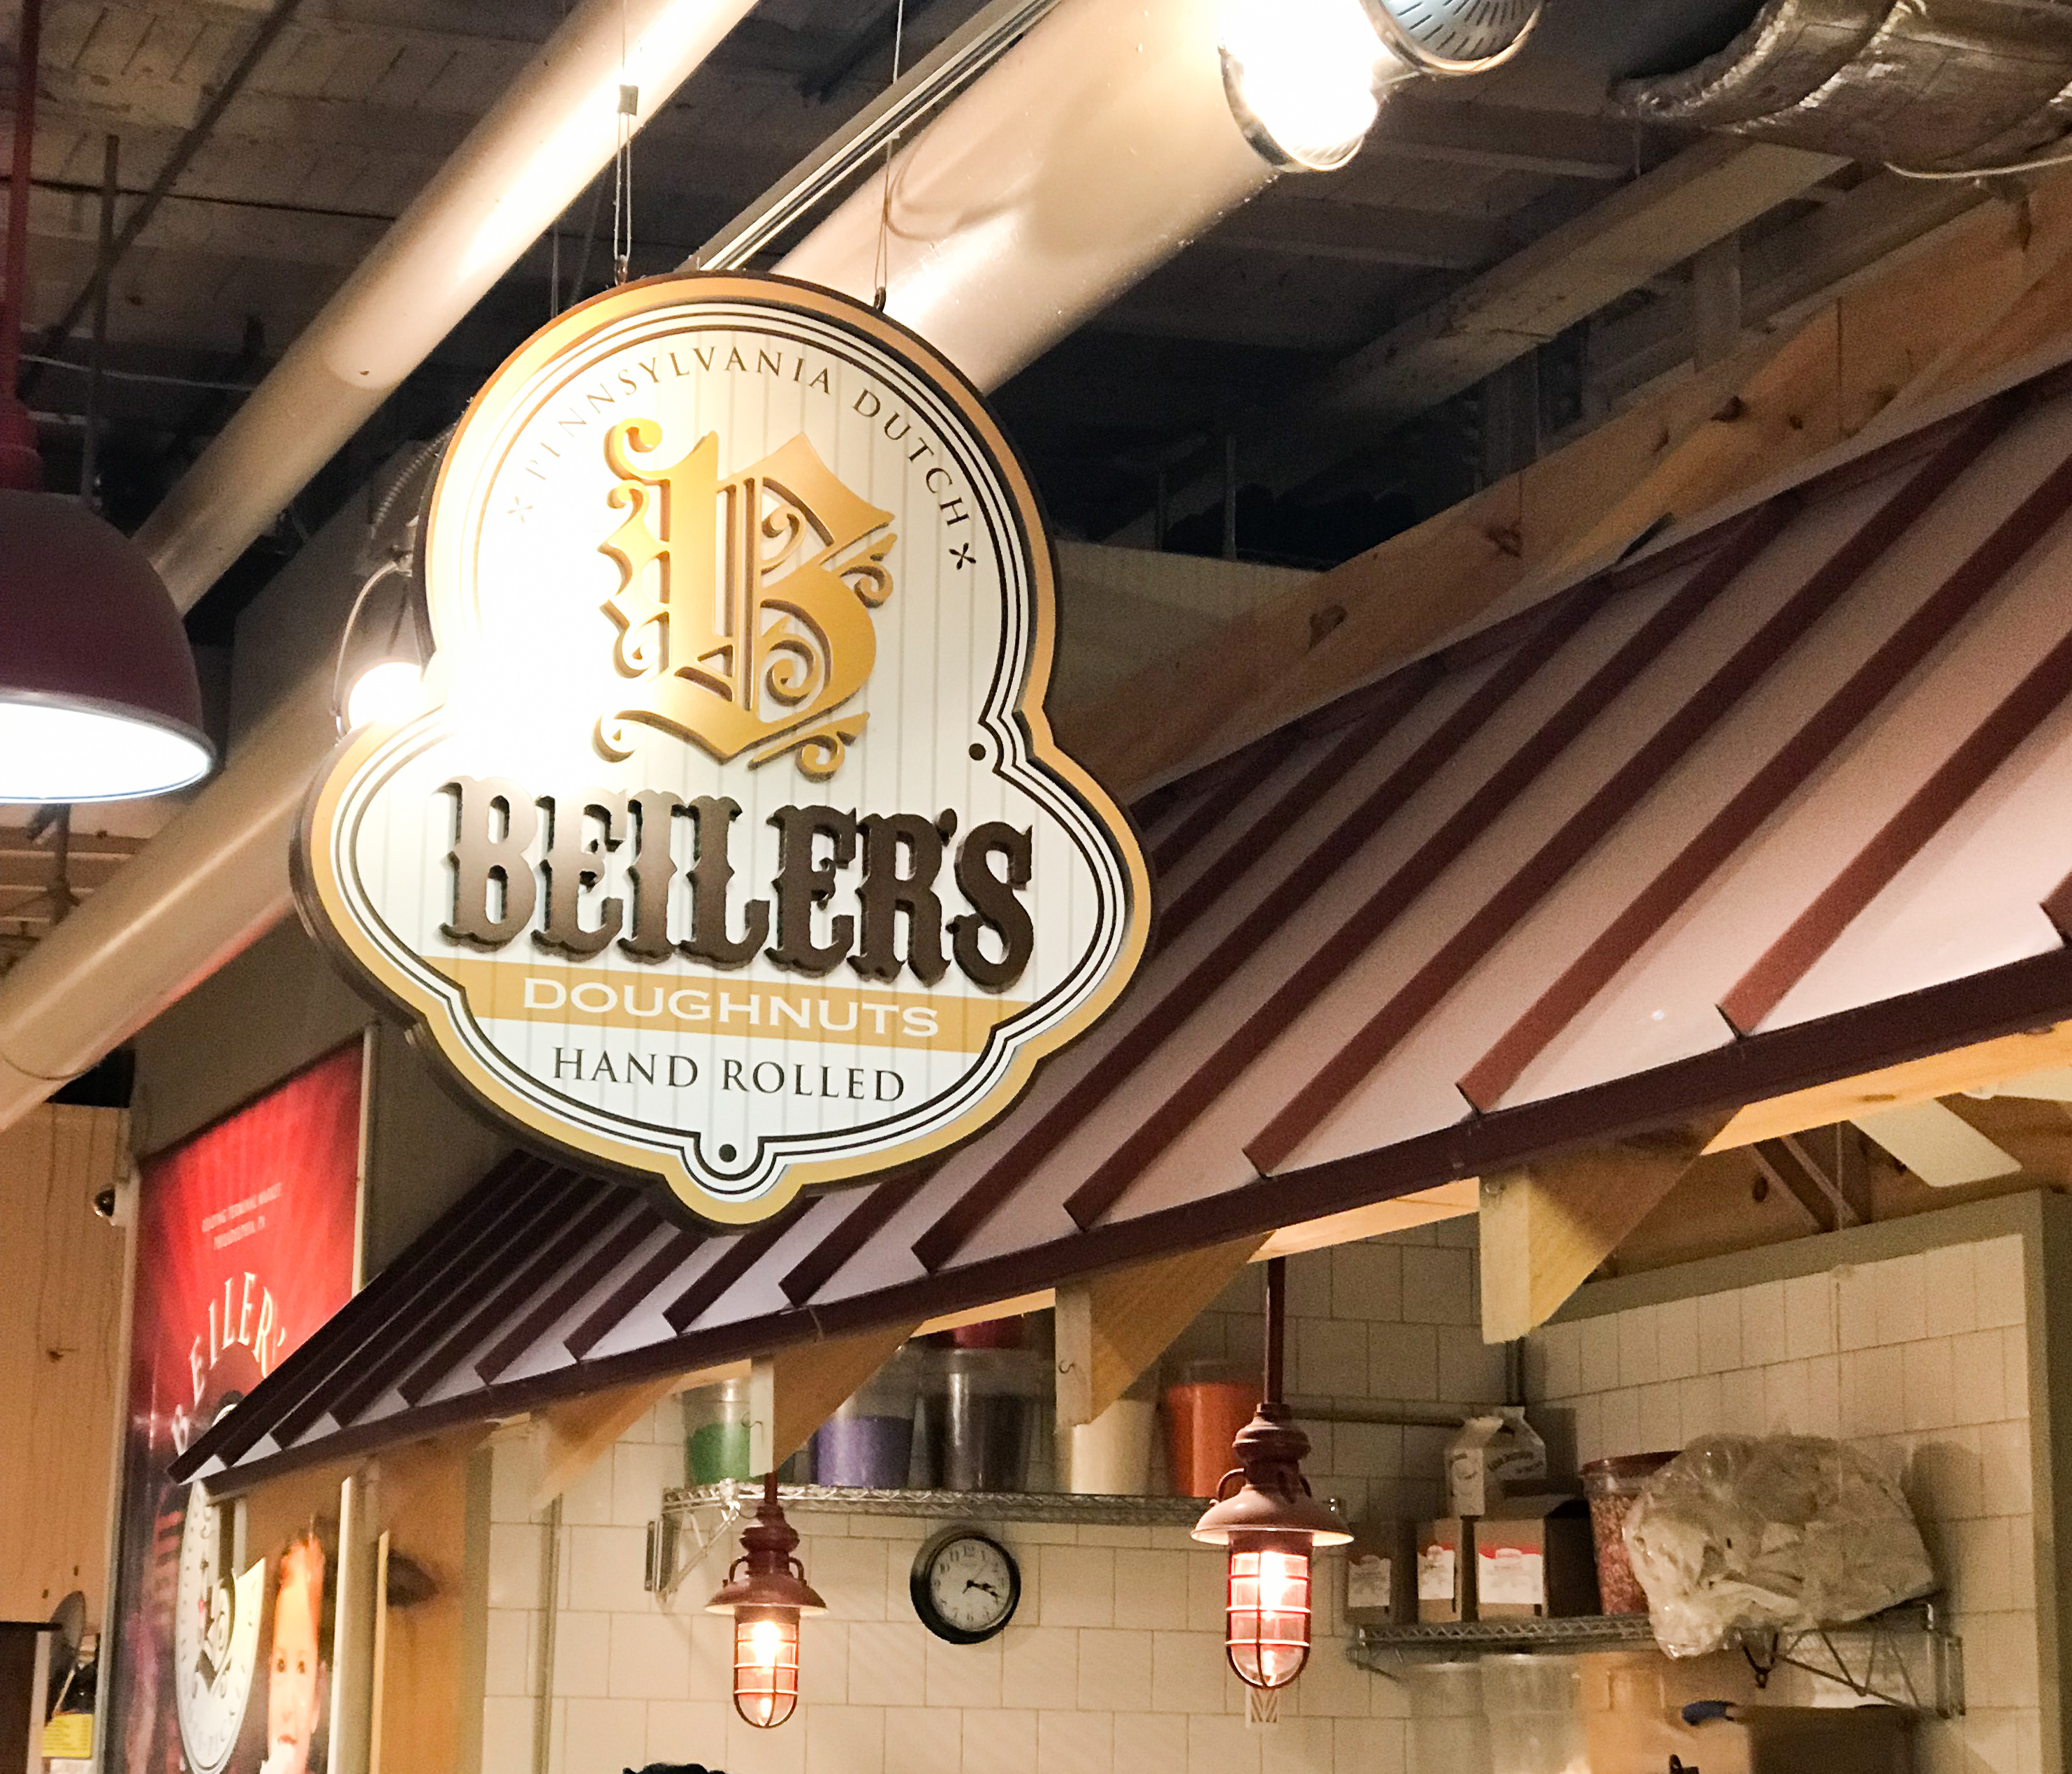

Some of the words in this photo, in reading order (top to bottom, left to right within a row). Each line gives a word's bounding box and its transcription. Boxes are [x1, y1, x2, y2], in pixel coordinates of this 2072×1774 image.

[852, 388, 970, 526] DUTCH
[435, 776, 1034, 994] BEILER'S
[523, 977, 939, 1037] DOUGHNUTS
[552, 1047, 698, 1088] HAND
[722, 1059, 905, 1102] ROLLED
[170, 1272, 286, 1457] BEILER'
